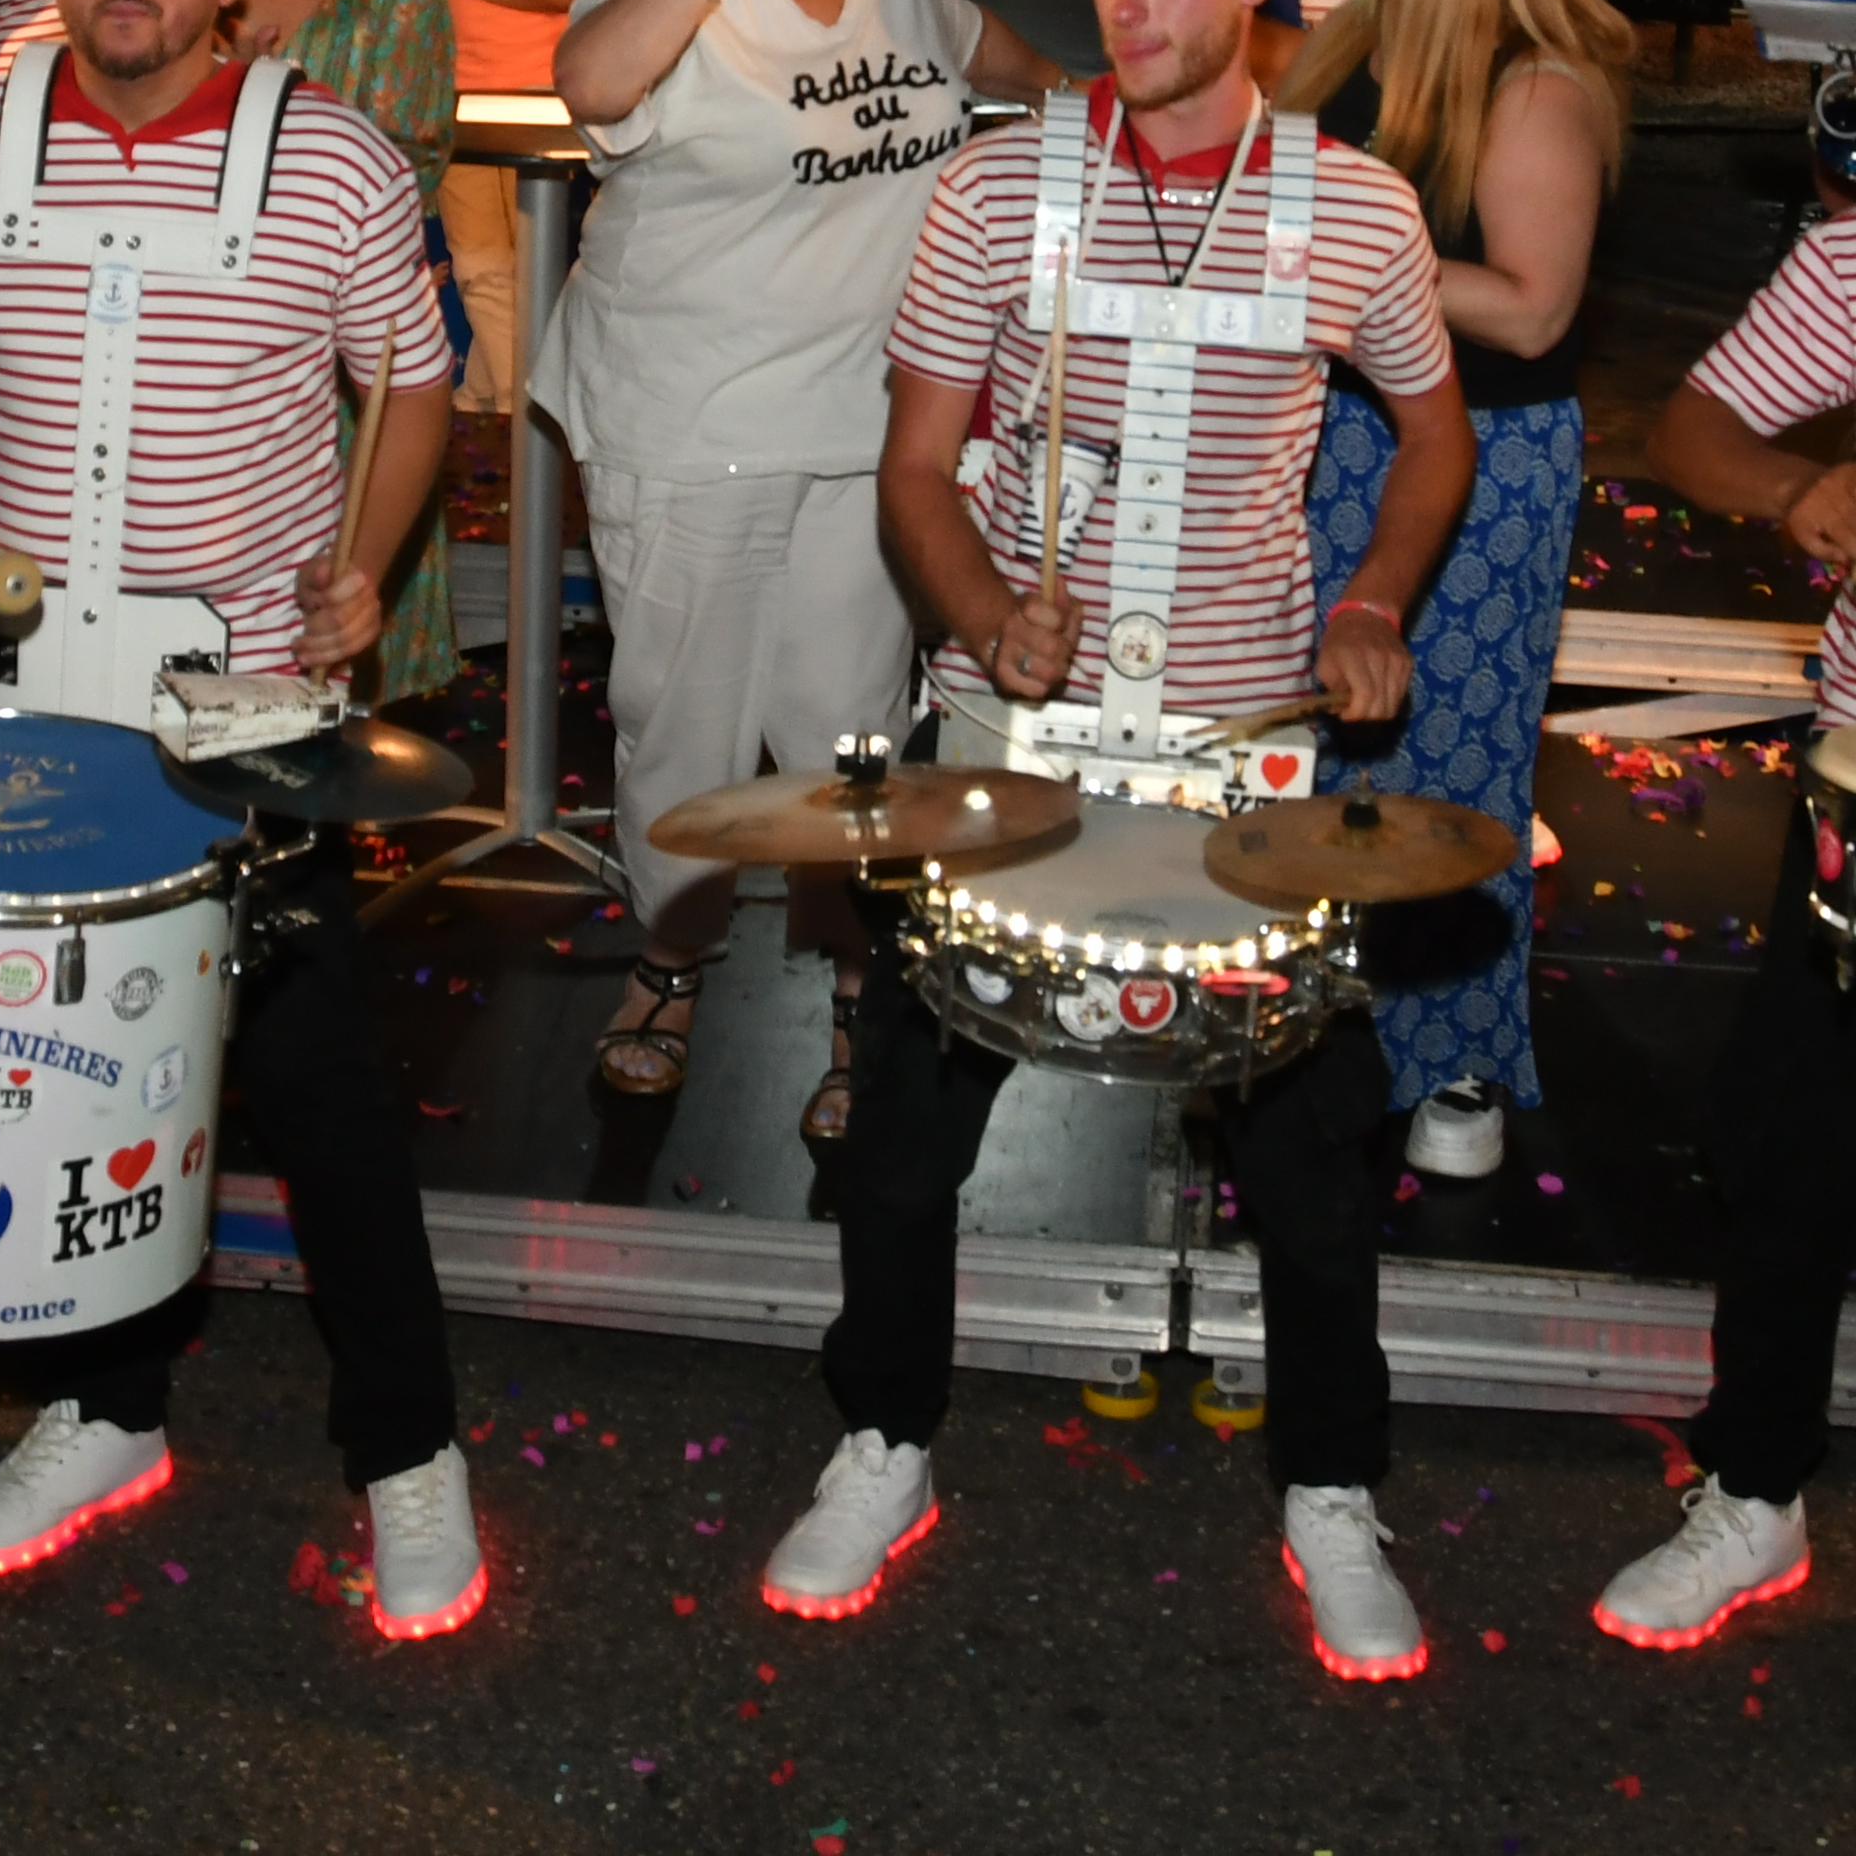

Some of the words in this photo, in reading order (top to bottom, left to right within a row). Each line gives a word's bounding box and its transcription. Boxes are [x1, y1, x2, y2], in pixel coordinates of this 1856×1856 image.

[852, 93, 910, 130] au
[58, 1156, 94, 1210] I
[50, 1184, 165, 1264] KTB
